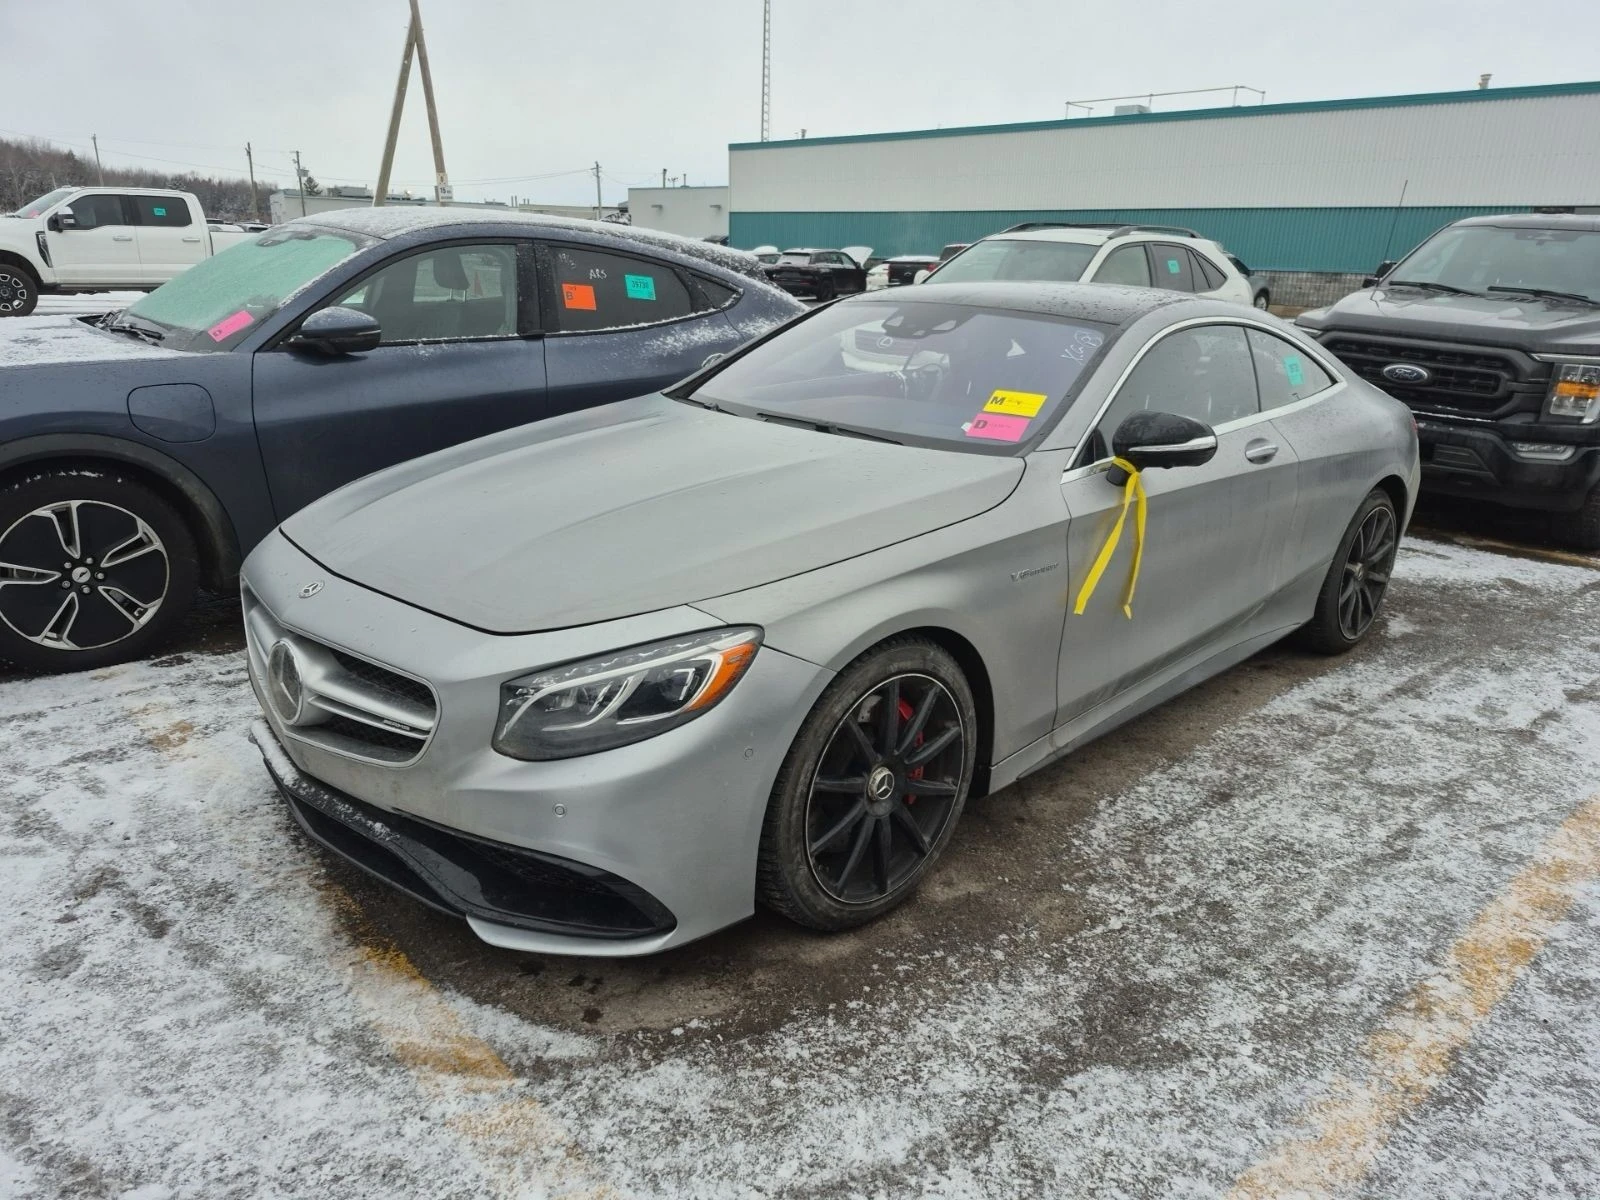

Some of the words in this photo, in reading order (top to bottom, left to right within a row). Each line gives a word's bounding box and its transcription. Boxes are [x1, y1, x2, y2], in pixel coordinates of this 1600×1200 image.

[1393, 368, 1417, 379] Ford
[990, 396, 1007, 406] M
[974, 420, 988, 430] D
